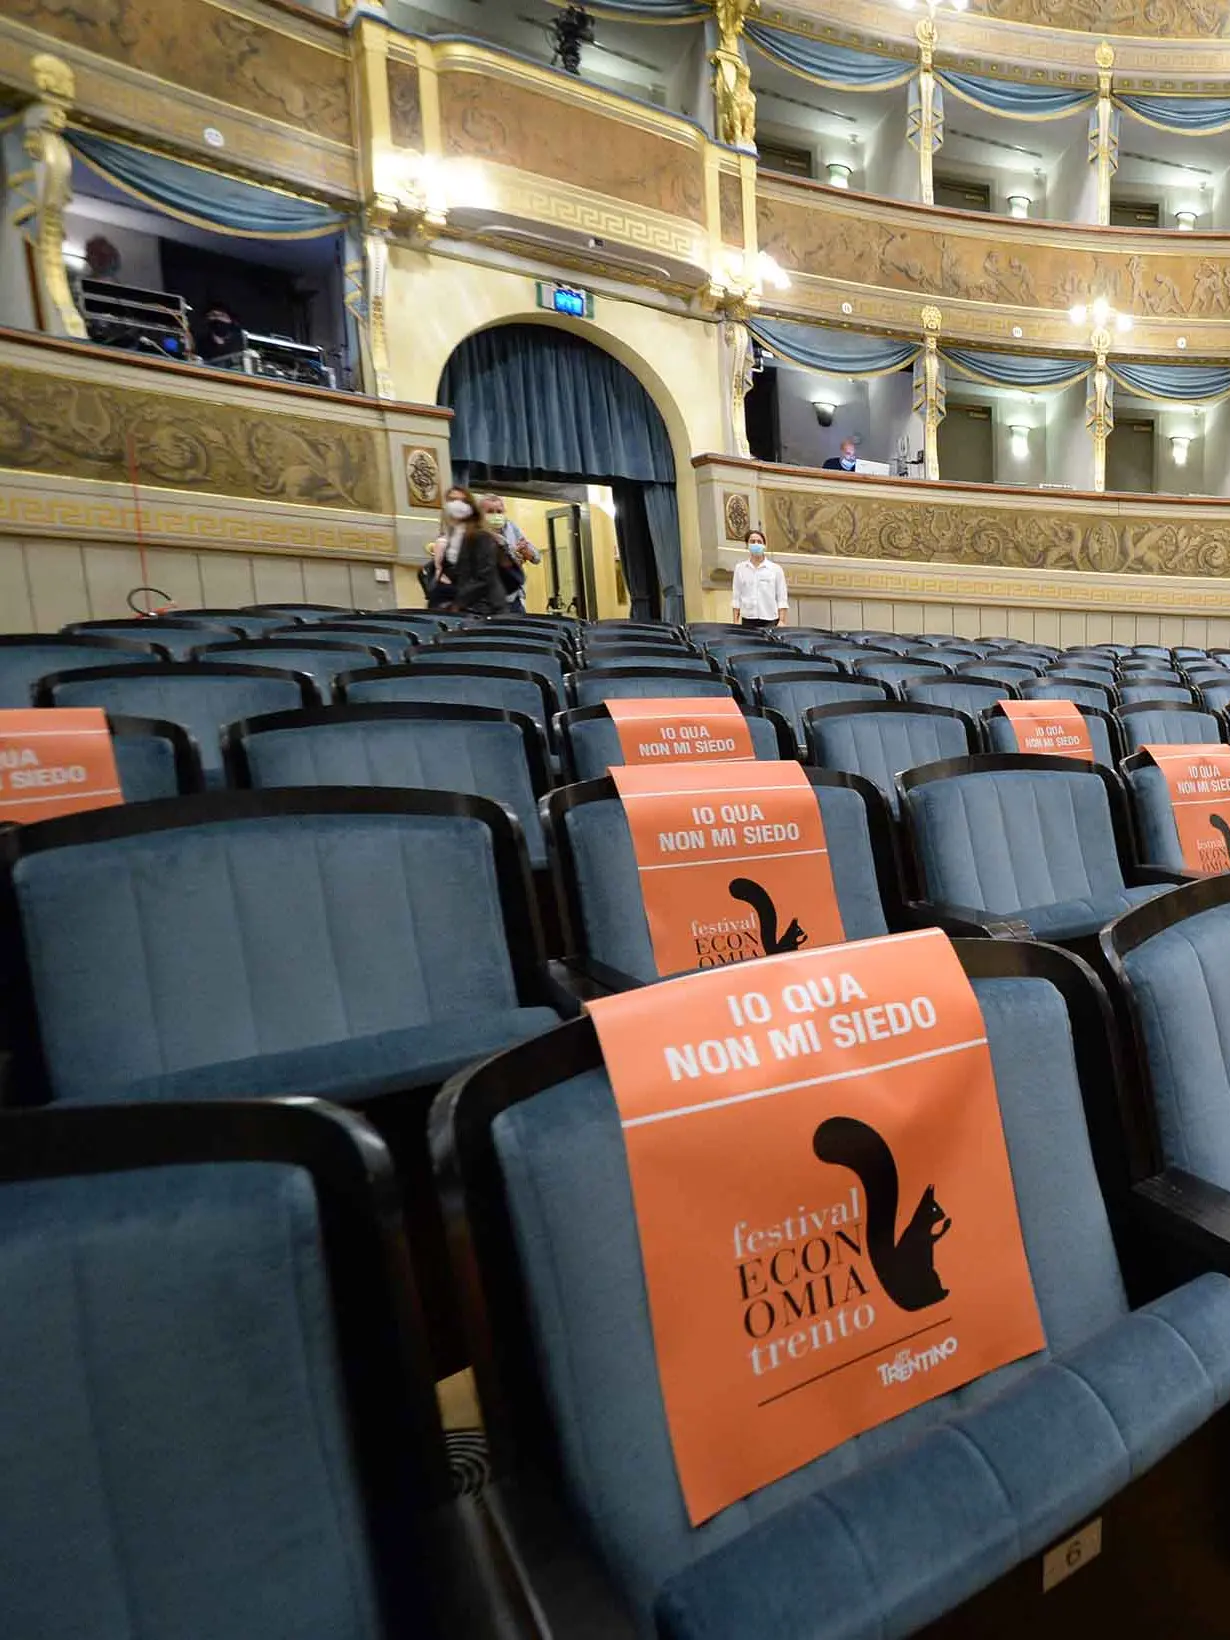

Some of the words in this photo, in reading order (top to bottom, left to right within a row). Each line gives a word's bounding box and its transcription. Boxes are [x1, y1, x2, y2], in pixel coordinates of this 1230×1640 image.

[639, 743, 670, 756] NON
[673, 742, 692, 754] MI
[695, 738, 735, 753] SIEDO
[660, 727, 676, 739] IO
[680, 726, 710, 739] QUA
[1187, 765, 1198, 778] IO
[1200, 764, 1221, 778] QUA
[691, 806, 716, 825] IO
[721, 804, 765, 824] QUA
[658, 830, 705, 852] NON
[710, 827, 737, 847] MI
[743, 822, 800, 845] SIEDO
[691, 911, 757, 938] festival
[695, 931, 760, 956] ECON
[727, 992, 772, 1027] IO
[782, 973, 868, 1013] QUA
[664, 1035, 760, 1081] NON
[767, 1020, 822, 1060] MI
[829, 996, 937, 1049] SIEDO
[733, 1187, 860, 1259] festival
[737, 1223, 862, 1301] ECON
[743, 1264, 870, 1339] OMIA
[749, 1303, 876, 1375] trento
[877, 1337, 958, 1386] TRENTINO
[1066, 1541, 1081, 1567] 6
